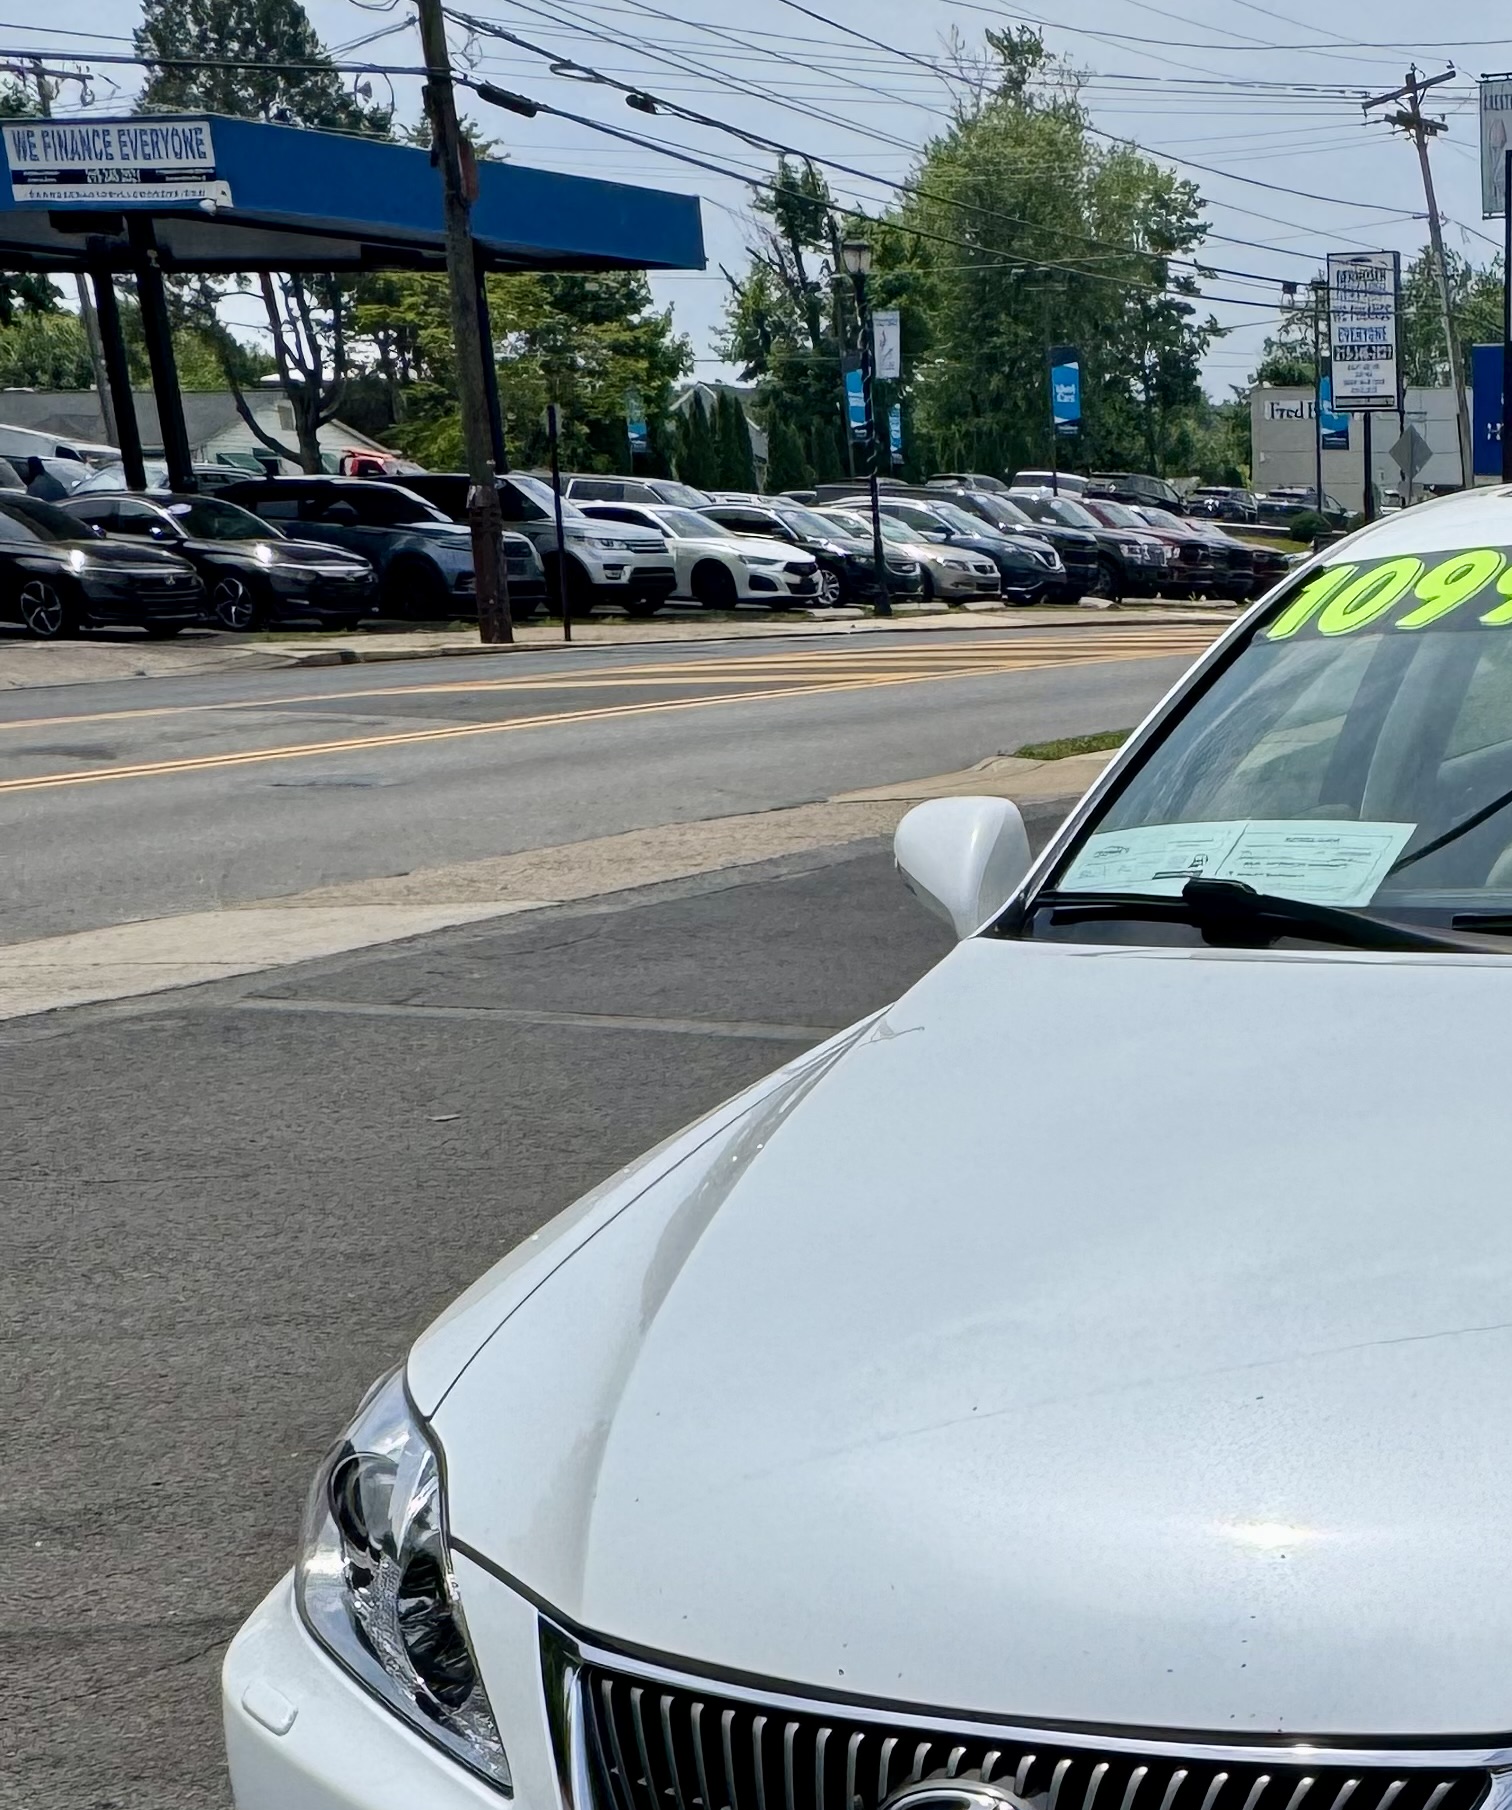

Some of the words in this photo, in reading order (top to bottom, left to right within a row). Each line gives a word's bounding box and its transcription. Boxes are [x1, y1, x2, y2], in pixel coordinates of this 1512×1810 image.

[12, 129, 40, 162] WE
[41, 128, 115, 162] FINANCE
[118, 127, 208, 161] EVERYONE
[1270, 402, 1303, 420] Fred
